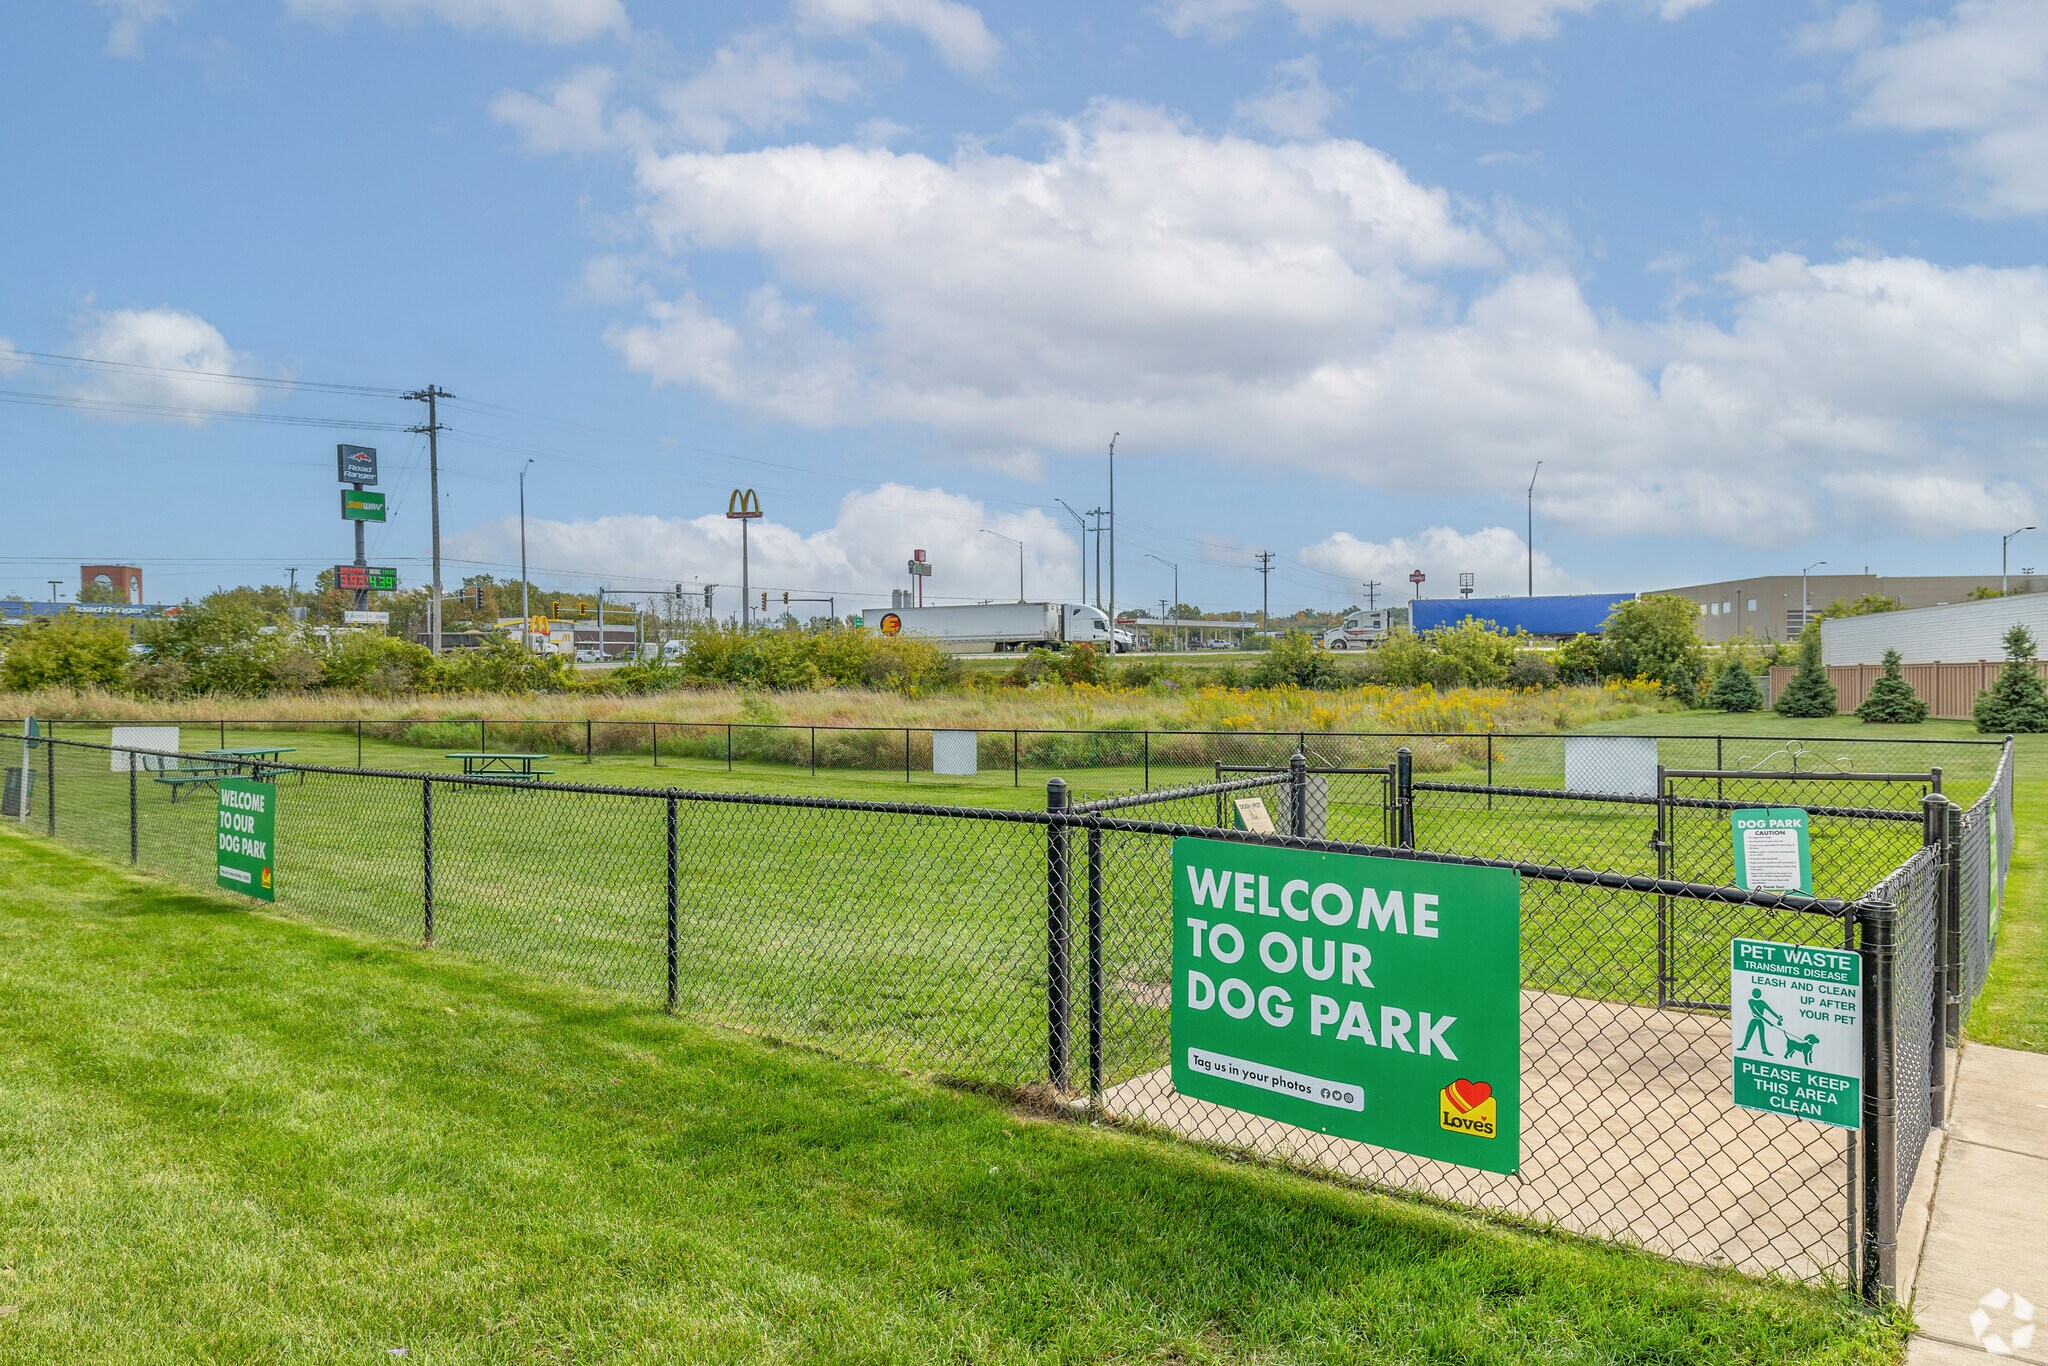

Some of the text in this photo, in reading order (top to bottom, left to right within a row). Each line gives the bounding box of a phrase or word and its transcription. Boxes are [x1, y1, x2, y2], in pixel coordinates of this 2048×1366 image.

[343, 470, 377, 480] Ranger
[347, 464, 372, 473] Road
[347, 500, 384, 511] SUBWAY
[104, 606, 147, 615] Ranger
[221, 788, 265, 813] WELCOME
[220, 810, 254, 834] TO OUR
[1737, 818, 1803, 829] DOG PARK
[219, 832, 266, 860] DOG PARK
[1186, 865, 1440, 939] WELCOME
[1187, 917, 1376, 989] TO OUR
[1740, 943, 1852, 971] PET WASTE
[1744, 960, 1848, 981] TRANSMITS DISEASE
[1751, 975, 1856, 998] LEASH AND CLEAN
[1188, 969, 1460, 1062] DOG PARK
[1800, 996, 1856, 1012] UP AFTER
[1799, 1009, 1856, 1025] YOUR PET
[1193, 1054, 1312, 1095] Tag us in your photos
[1742, 1062, 1850, 1092] PLEASE KEEP
[1753, 1078, 1839, 1105] THIS AREA
[1769, 1096, 1822, 1116] CLEAN
